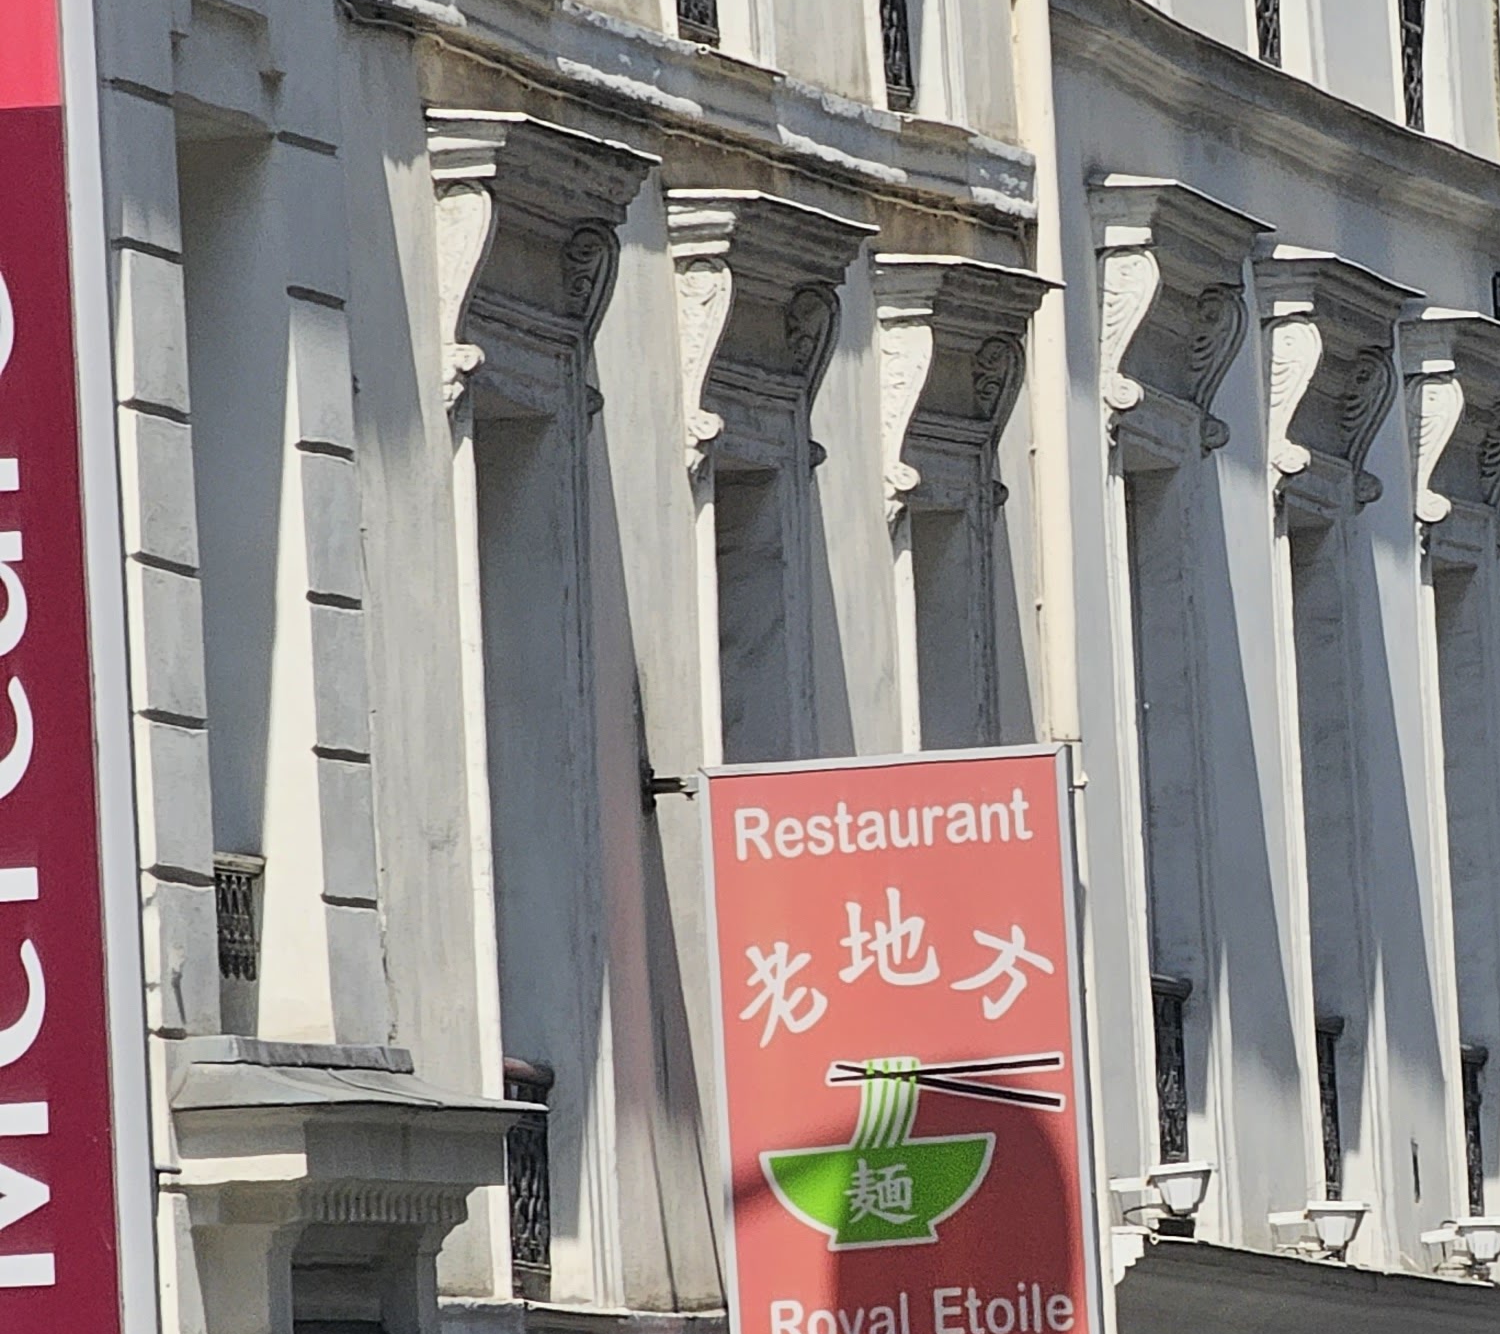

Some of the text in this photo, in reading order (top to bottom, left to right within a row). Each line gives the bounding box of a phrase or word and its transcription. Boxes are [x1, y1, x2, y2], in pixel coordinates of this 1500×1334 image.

[734, 787, 1033, 861] Restaurant
[739, 886, 1054, 1048] 老地方
